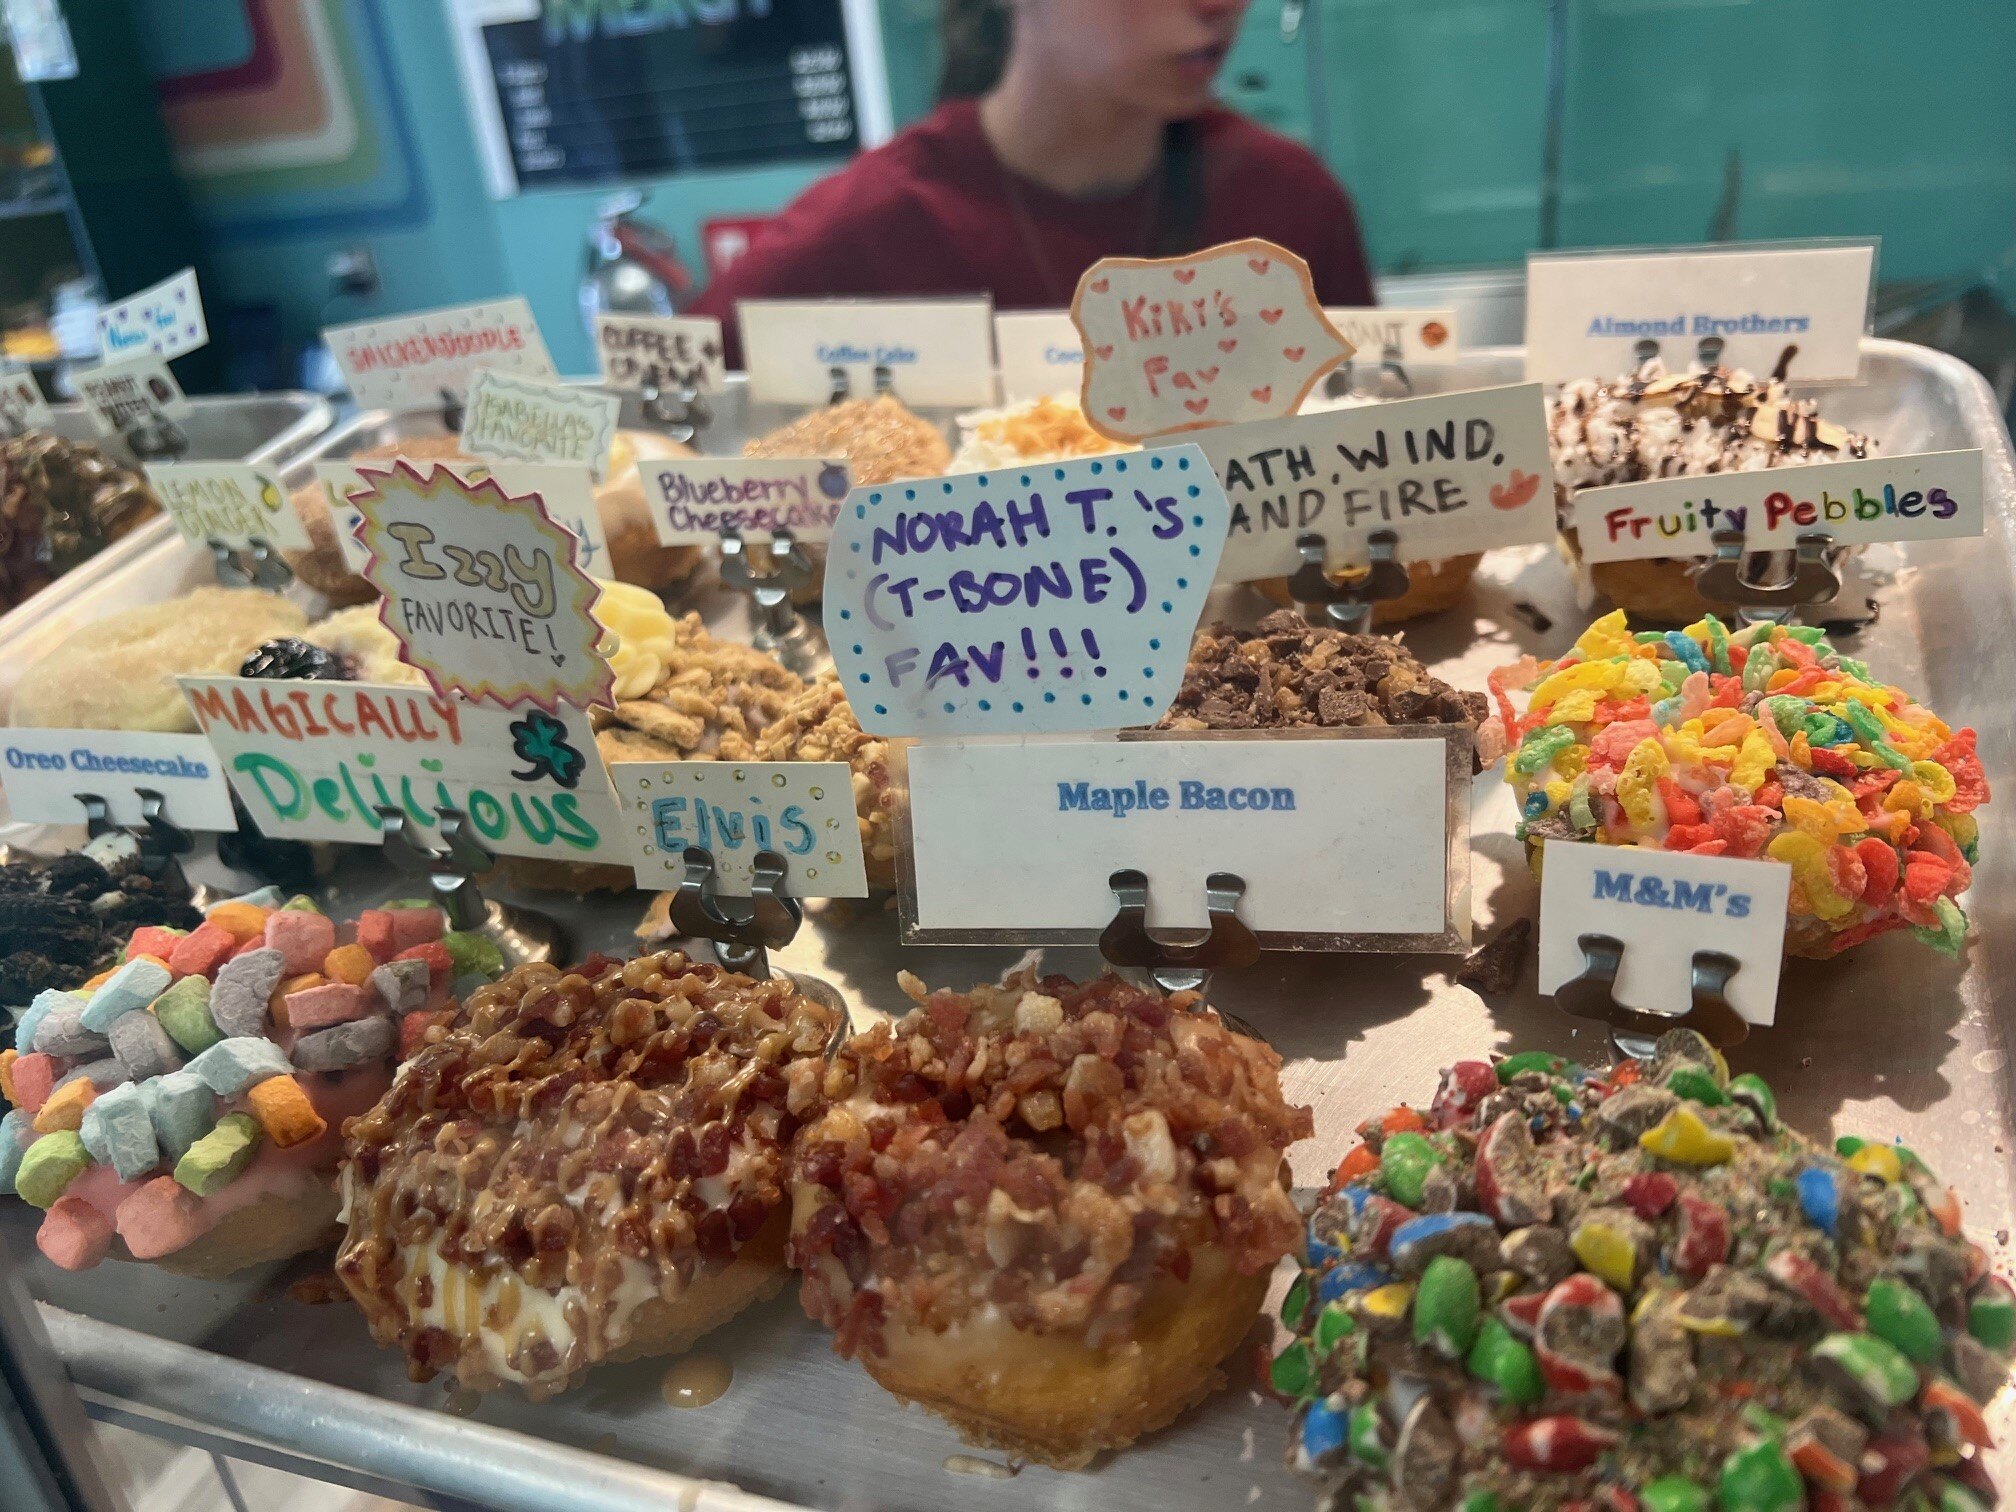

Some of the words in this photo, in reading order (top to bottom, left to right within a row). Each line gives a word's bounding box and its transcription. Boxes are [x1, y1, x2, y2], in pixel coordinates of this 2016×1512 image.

[349, 324, 526, 373] SNICKERDOODLE
[1586, 314, 1687, 337] Almond
[1691, 313, 1811, 336] Brothers
[1143, 356, 1220, 399] Fav
[872, 493, 1051, 566] NORAH
[1228, 488, 1326, 537] AND
[1344, 478, 1469, 528] FIRE
[1604, 497, 1748, 543] Fruity
[1764, 482, 1960, 532] Pebbles
[387, 521, 557, 619] Izzy
[864, 547, 1147, 632] (T-BONE)
[402, 598, 568, 668] FAVORITE!
[189, 685, 463, 746] MAGICALLY
[6, 747, 66, 771] Oreo
[70, 749, 210, 780] Cheesecake
[1057, 779, 1170, 818] Maple
[1179, 780, 1297, 811] Bacon
[1593, 869, 1752, 918] M&M's
